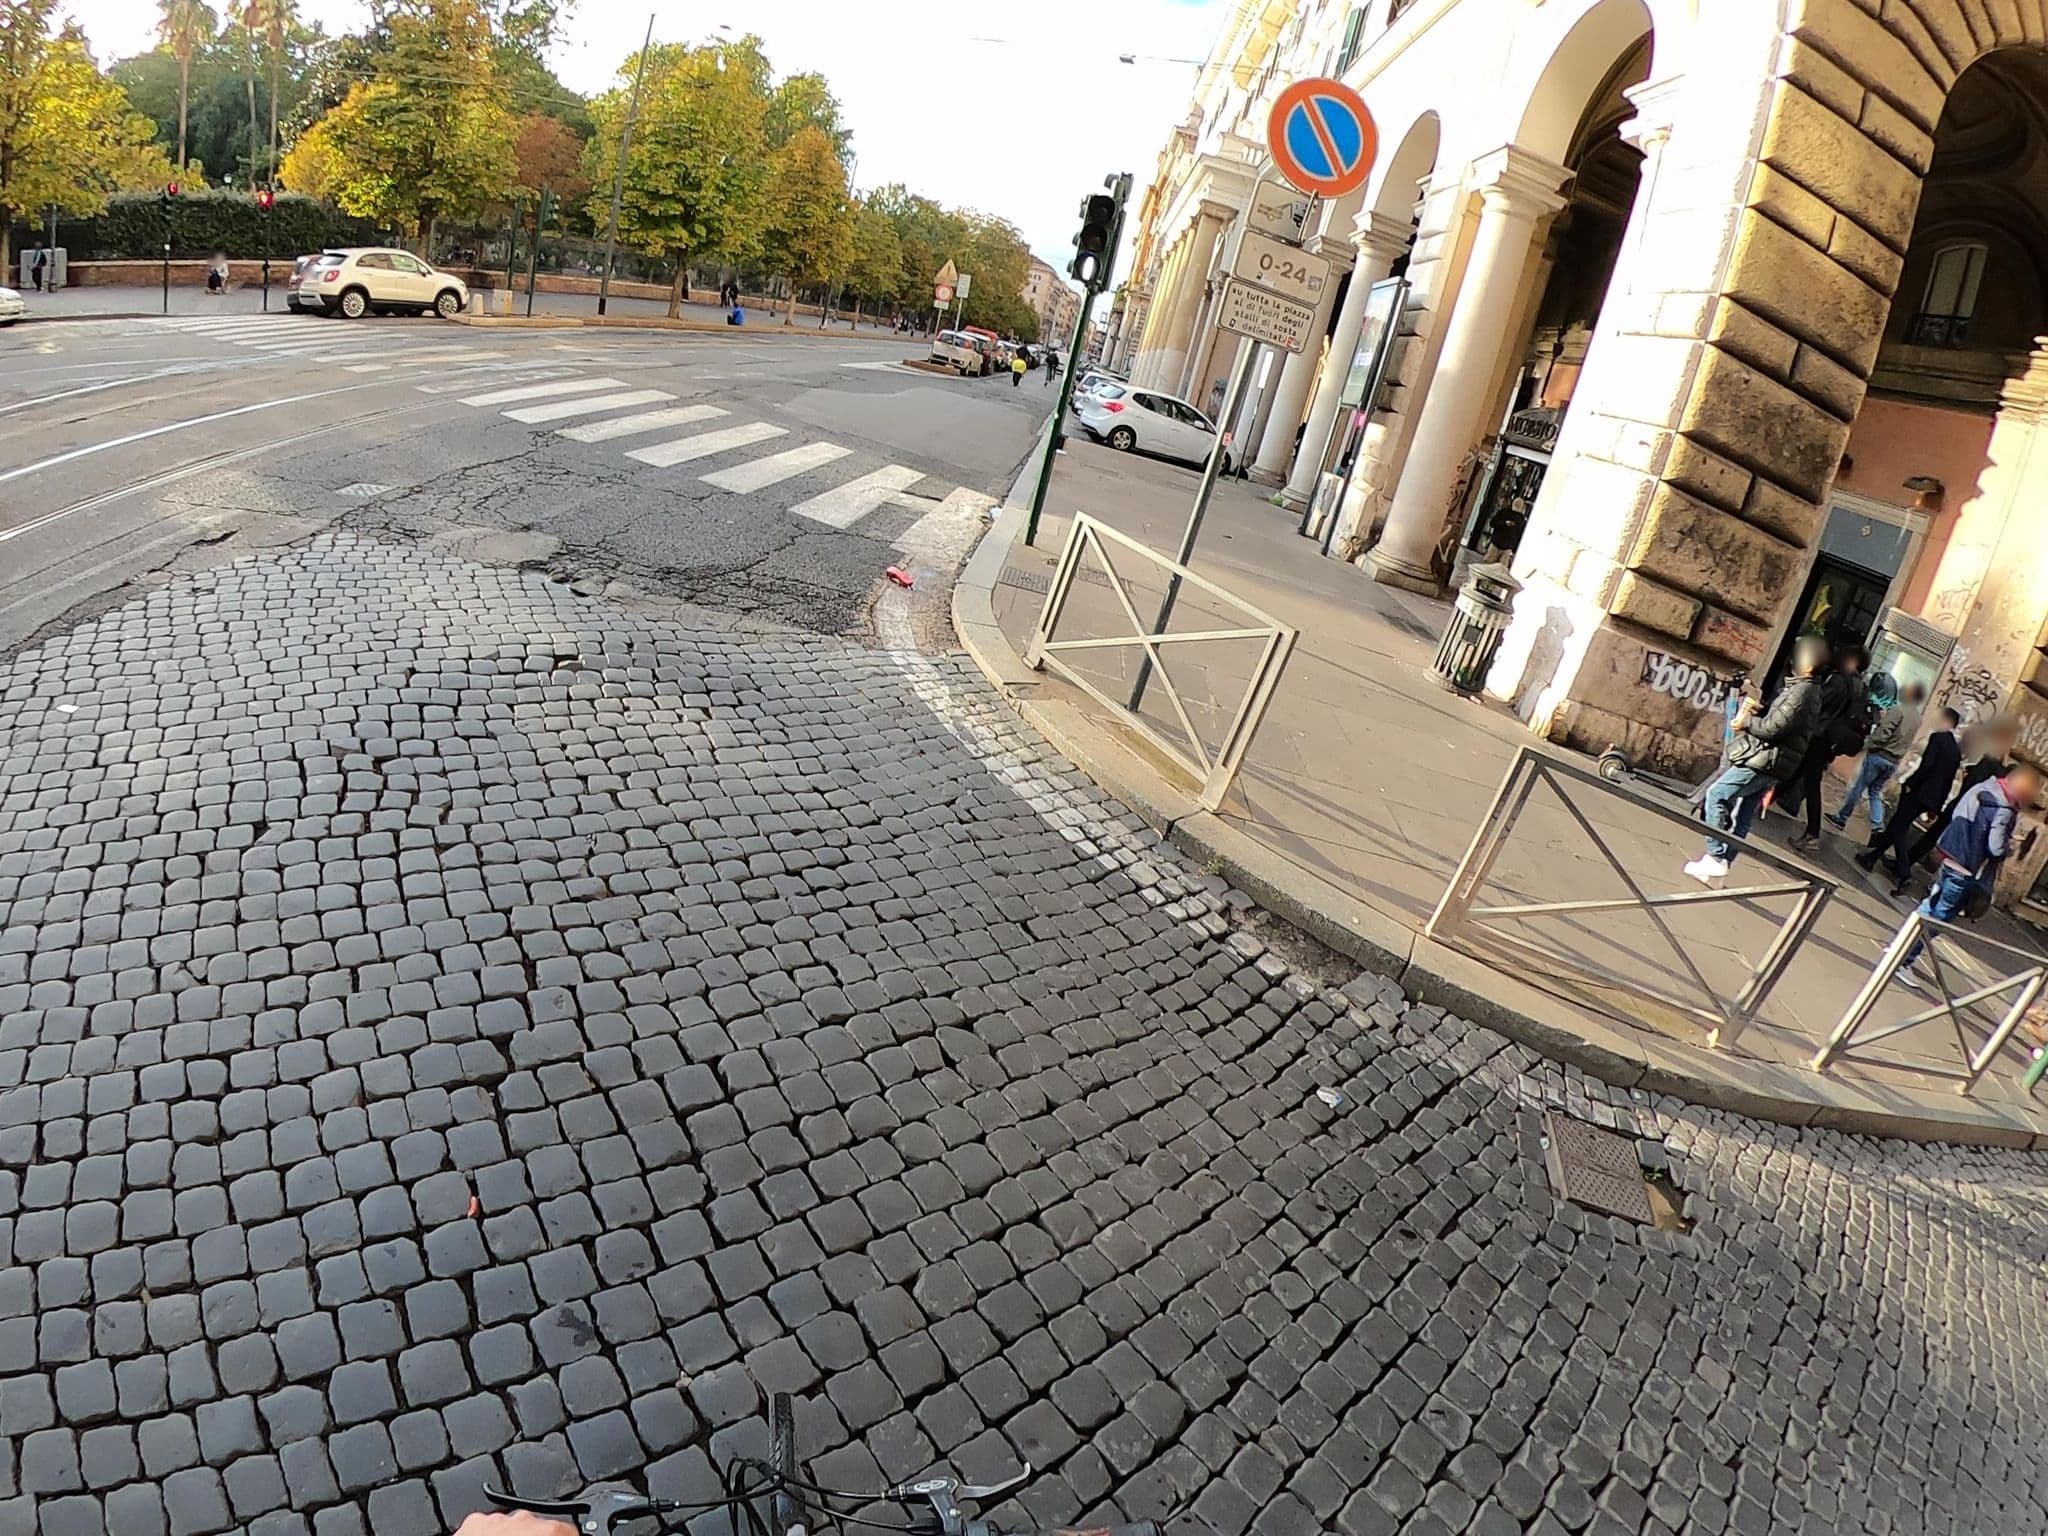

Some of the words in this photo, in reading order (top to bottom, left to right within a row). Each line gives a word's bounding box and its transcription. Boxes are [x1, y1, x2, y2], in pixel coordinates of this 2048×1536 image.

[1259, 253, 1307, 284] 0-24
[1232, 287, 1243, 296] su
[1246, 291, 1269, 305] tutta
[1272, 300, 1281, 309] la
[1284, 305, 1310, 320] piazza
[1234, 299, 1243, 307] al
[1246, 303, 1255, 311] di
[1258, 306, 1280, 319] fuori
[1282, 315, 1304, 328] degli
[1235, 310, 1259, 323] stalli
[1261, 317, 1270, 327] di
[1273, 323, 1297, 336] sosta
